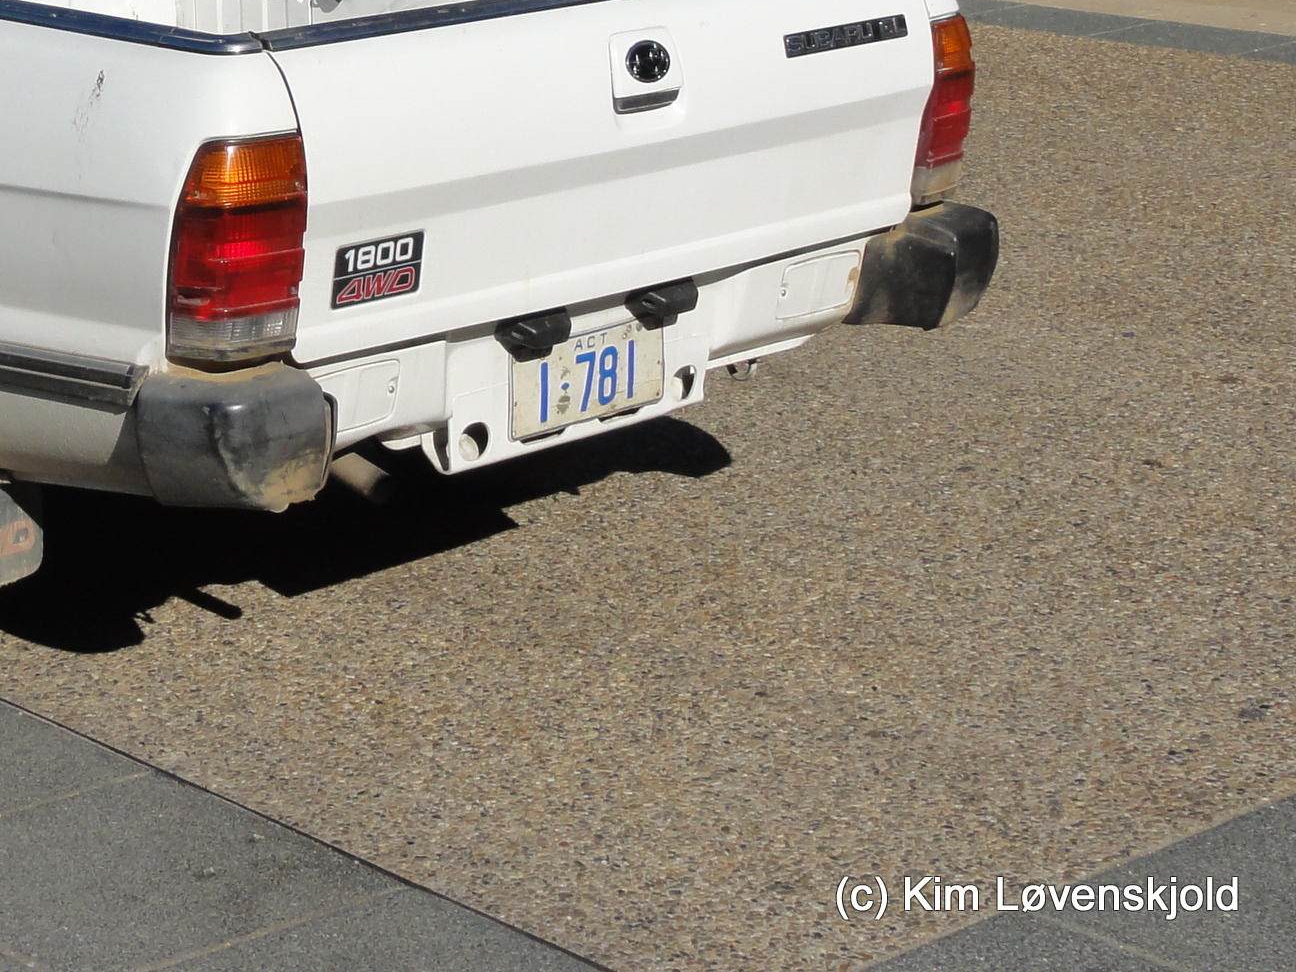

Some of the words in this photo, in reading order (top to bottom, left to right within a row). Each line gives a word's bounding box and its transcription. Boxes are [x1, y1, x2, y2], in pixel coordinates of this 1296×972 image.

[786, 22, 874, 53] SUBARU
[345, 237, 414, 272] 1800
[336, 266, 415, 304] 4WD
[574, 332, 608, 351] ACT
